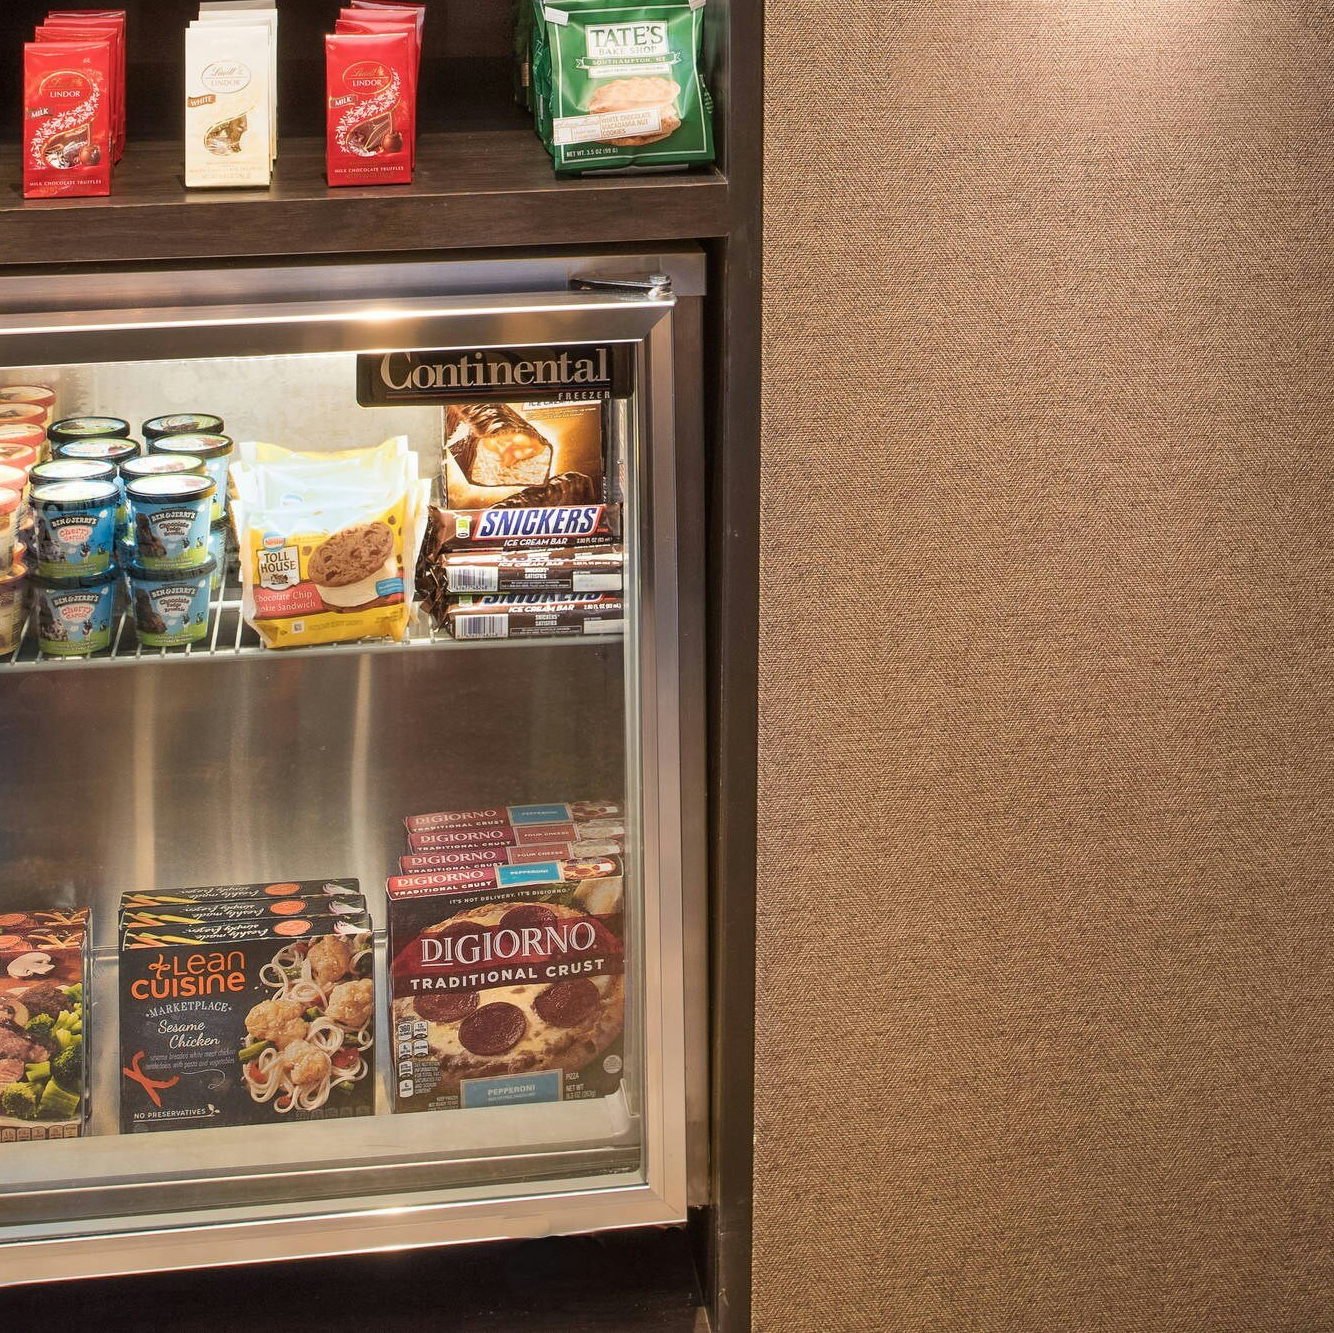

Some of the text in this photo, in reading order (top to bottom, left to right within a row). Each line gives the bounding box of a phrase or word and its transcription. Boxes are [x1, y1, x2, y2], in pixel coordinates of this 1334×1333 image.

[598, 45, 657, 56] BAKE SHOP
[352, 79, 383, 87] LINDOR
[50, 90, 81, 98] LINDOR
[190, 95, 213, 106] WHITE
[334, 97, 352, 106] MILK
[31, 108, 49, 118] MILK
[380, 348, 611, 391] Continental
[558, 391, 610, 400] FREEZER
[480, 507, 598, 537] SNICKERS
[264, 552, 290, 563] TOLL
[261, 561, 296, 573] HOUSE
[278, 601, 316, 612] Sandwich
[394, 880, 492, 896] TRADITIONAL CRUST
[173, 950, 245, 975] Lean
[411, 958, 606, 991] TRADITIONAL CRUST
[131, 972, 246, 1000] cuisine
[149, 1001, 229, 1018] MARKETPLACE
[158, 1019, 206, 1034] Sesame
[169, 1034, 220, 1050] Chicken
[487, 1084, 536, 1096] PEPPERONI
[147, 1108, 206, 1119] PRESERVATIVES
